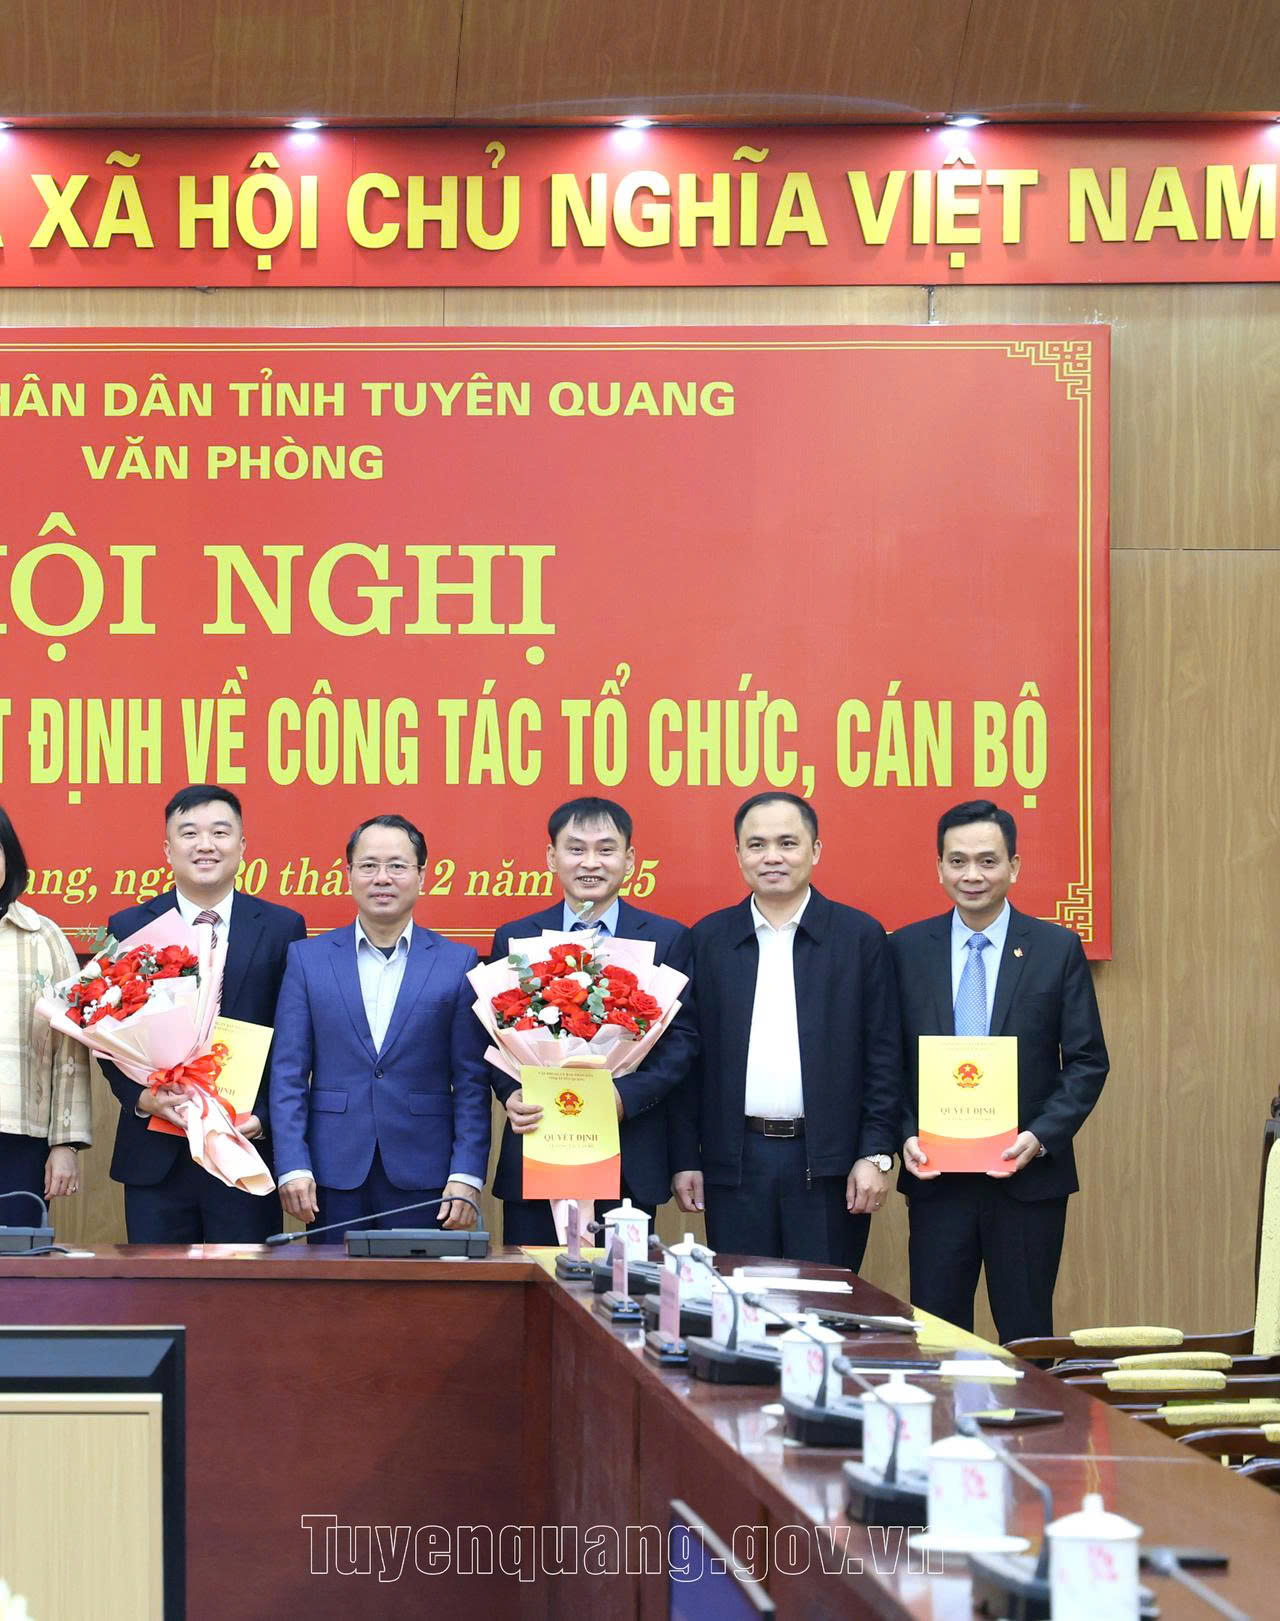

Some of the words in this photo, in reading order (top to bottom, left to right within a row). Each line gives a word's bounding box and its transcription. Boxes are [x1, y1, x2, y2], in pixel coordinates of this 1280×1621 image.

[29, 151, 155, 248] XÃ
[179, 150, 319, 272] HỘI
[346, 141, 521, 250] CHỦ
[550, 145, 829, 248] NGHĨA
[847, 145, 1039, 269] VIỆT
[1067, 163, 1278, 244] NAM
[104, 373, 212, 417] DÂN
[229, 366, 344, 417] TỈNH
[362, 372, 530, 417] TUYÊN
[549, 381, 735, 418] QUANG
[81, 436, 188, 480] VĂN
[208, 436, 384, 481] PHÒNG
[203, 542, 557, 667] NGHỊ
[27, 697, 162, 805] ĐỊNH
[180, 665, 249, 785] VỀ
[267, 678, 419, 786] CÔNG
[437, 678, 545, 787] TÁC
[560, 661, 632, 787] TỔ
[648, 672, 816, 799] CHỨC,
[836, 679, 953, 788] CÁN
[972, 680, 1048, 809] BỘ
[278, 855, 352, 896] thá
[419, 858, 456, 896] 2
[463, 857, 554, 897] năm
